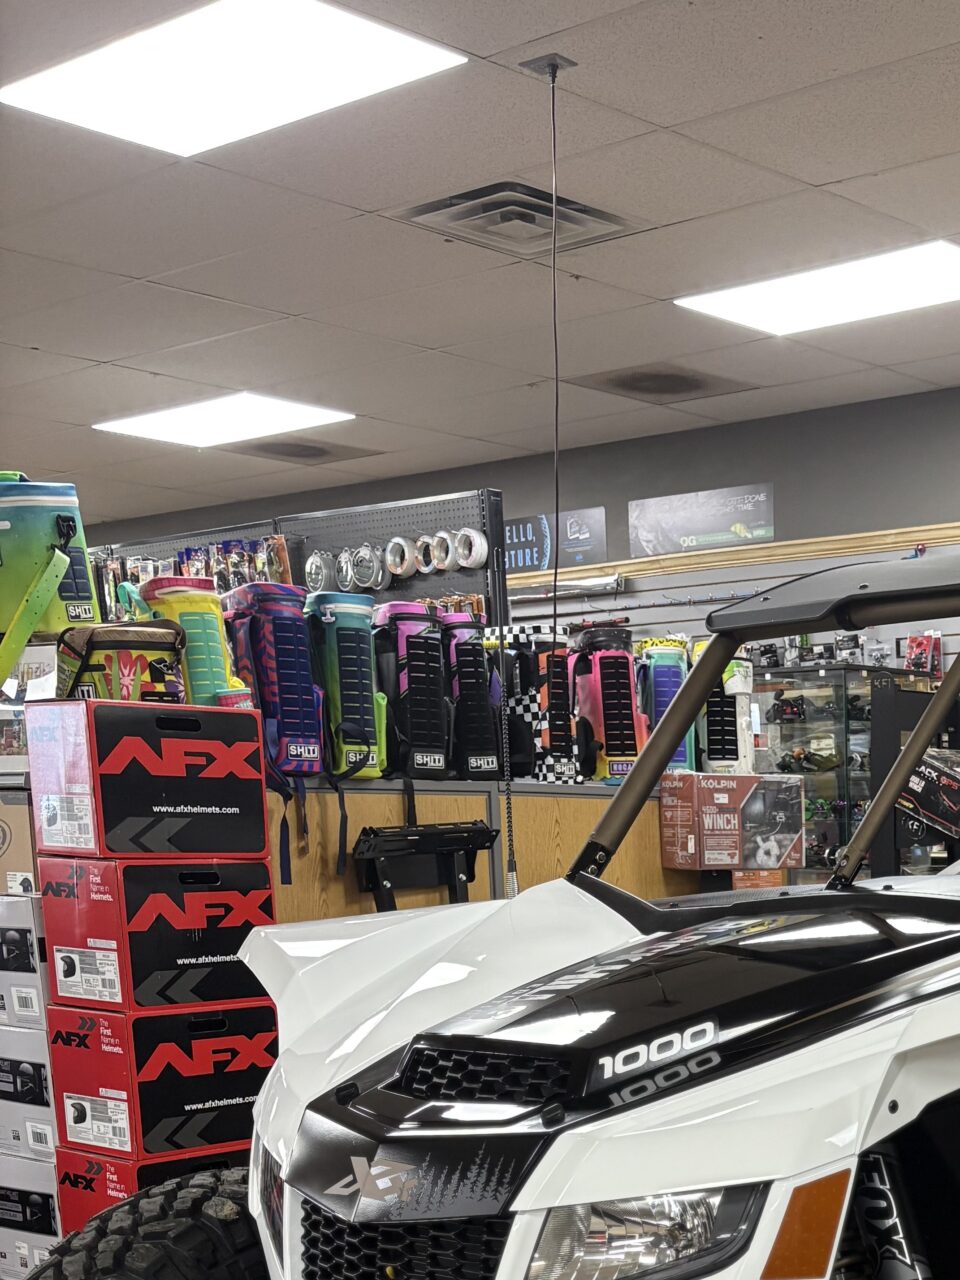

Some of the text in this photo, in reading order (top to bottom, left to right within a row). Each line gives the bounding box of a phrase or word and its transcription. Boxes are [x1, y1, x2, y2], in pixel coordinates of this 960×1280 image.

[505, 523, 536, 544] ELLO,
[505, 547, 538, 569] TURE
[874, 677, 891, 689] KFI
[99, 736, 262, 779] AFX
[700, 779, 737, 789] KOLPIN
[152, 804, 240, 814] www.afxhelmets.com
[703, 813, 739, 830] WINCH
[42, 881, 79, 899] AFX
[127, 888, 277, 932] AFX
[99, 1018, 109, 1027] The
[51, 1030, 91, 1049] AFX
[137, 1031, 279, 1083] AFX
[598, 1021, 715, 1079] 1000
[106, 1163, 115, 1173] The
[106, 1172, 118, 1181] First
[59, 1171, 96, 1192] AFX
